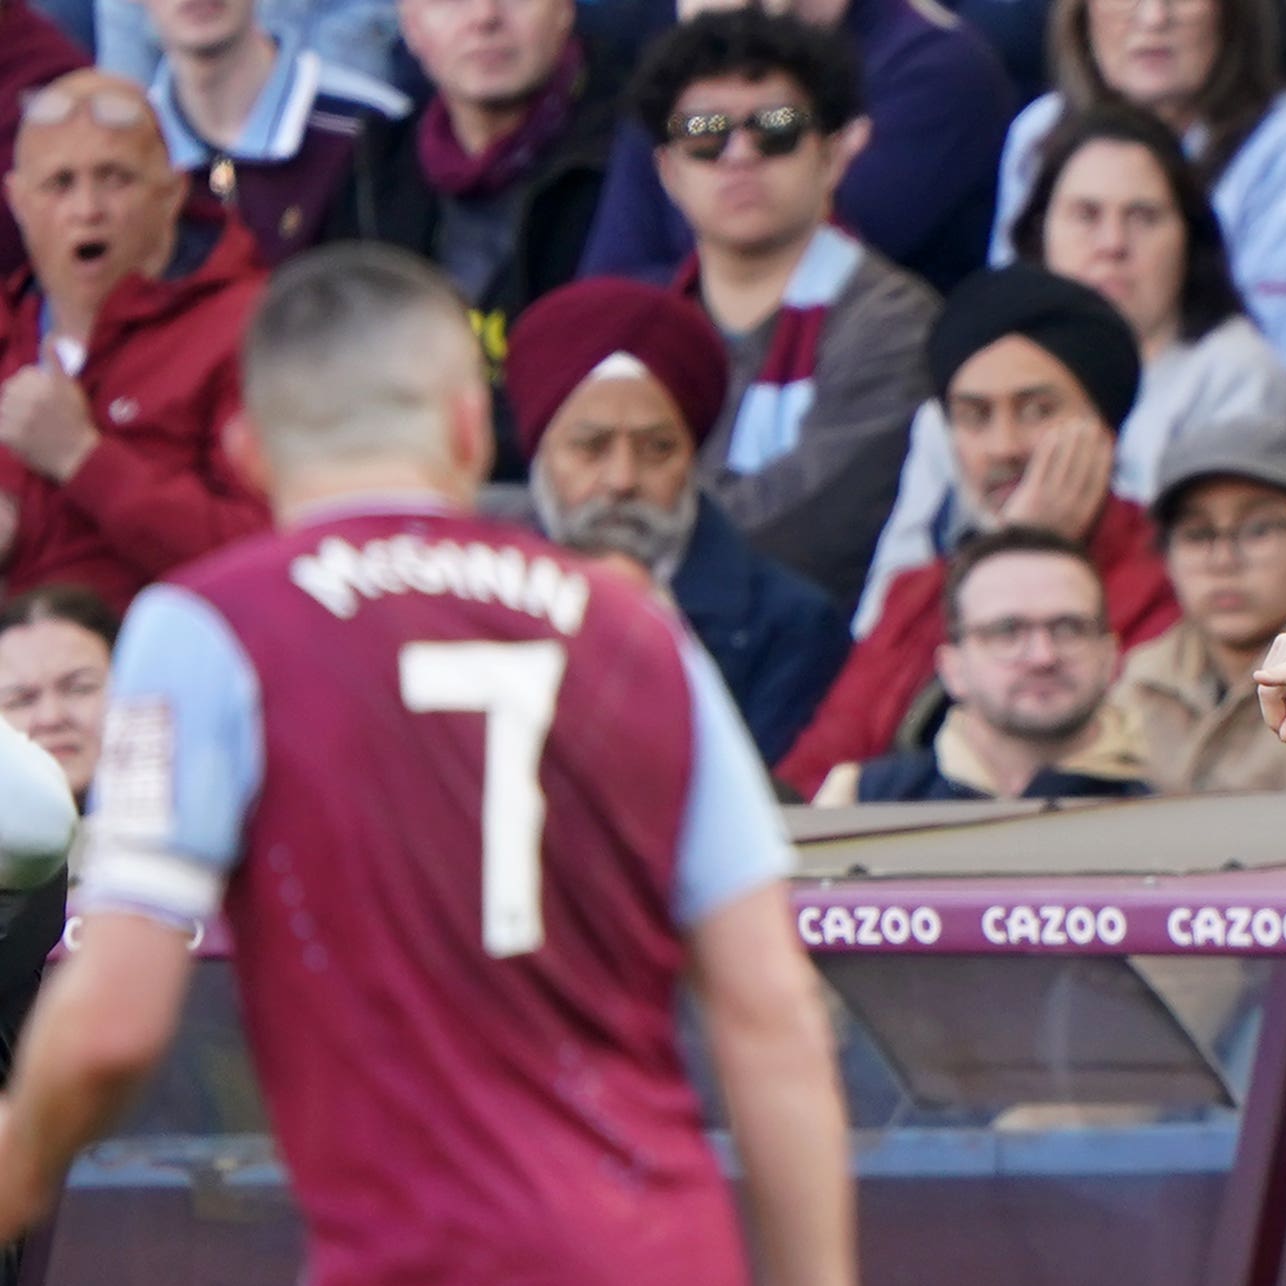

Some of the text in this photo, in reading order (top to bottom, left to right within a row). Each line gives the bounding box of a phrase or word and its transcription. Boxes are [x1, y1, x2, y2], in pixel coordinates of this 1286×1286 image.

[398, 640, 567, 959] 7
[799, 905, 942, 946] CAZOO
[981, 905, 1127, 946] CAZOO
